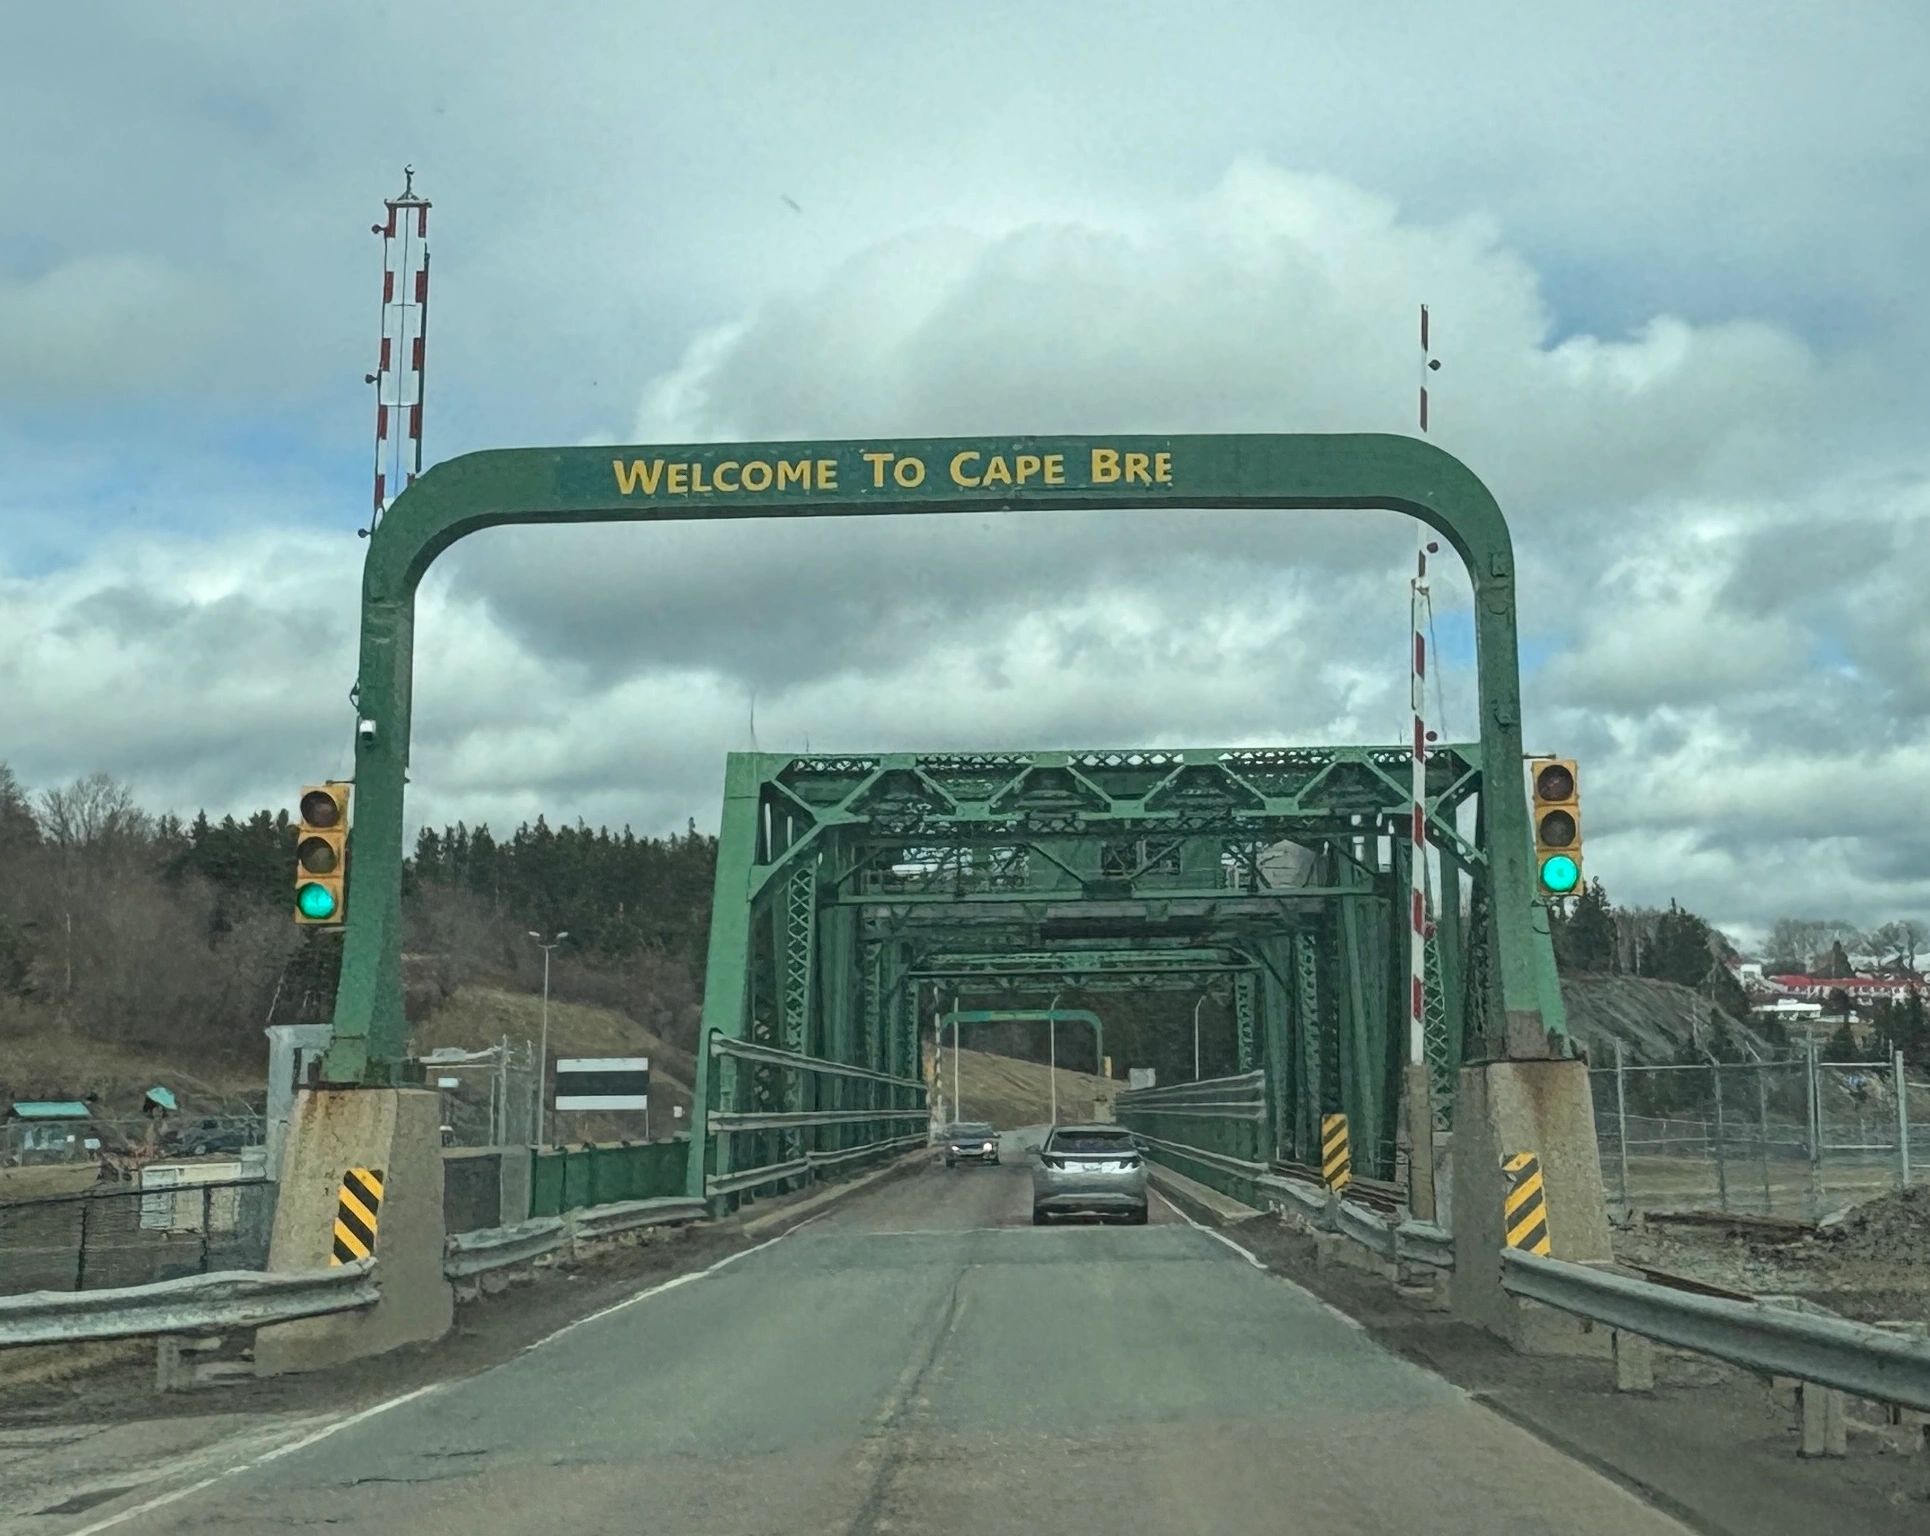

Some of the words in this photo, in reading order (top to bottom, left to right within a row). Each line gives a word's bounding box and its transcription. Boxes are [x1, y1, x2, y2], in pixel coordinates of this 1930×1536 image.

[613, 458, 838, 495] WELCOME
[863, 452, 926, 488] TO
[949, 450, 1066, 487] CAPE
[1091, 448, 1172, 483] BRE
